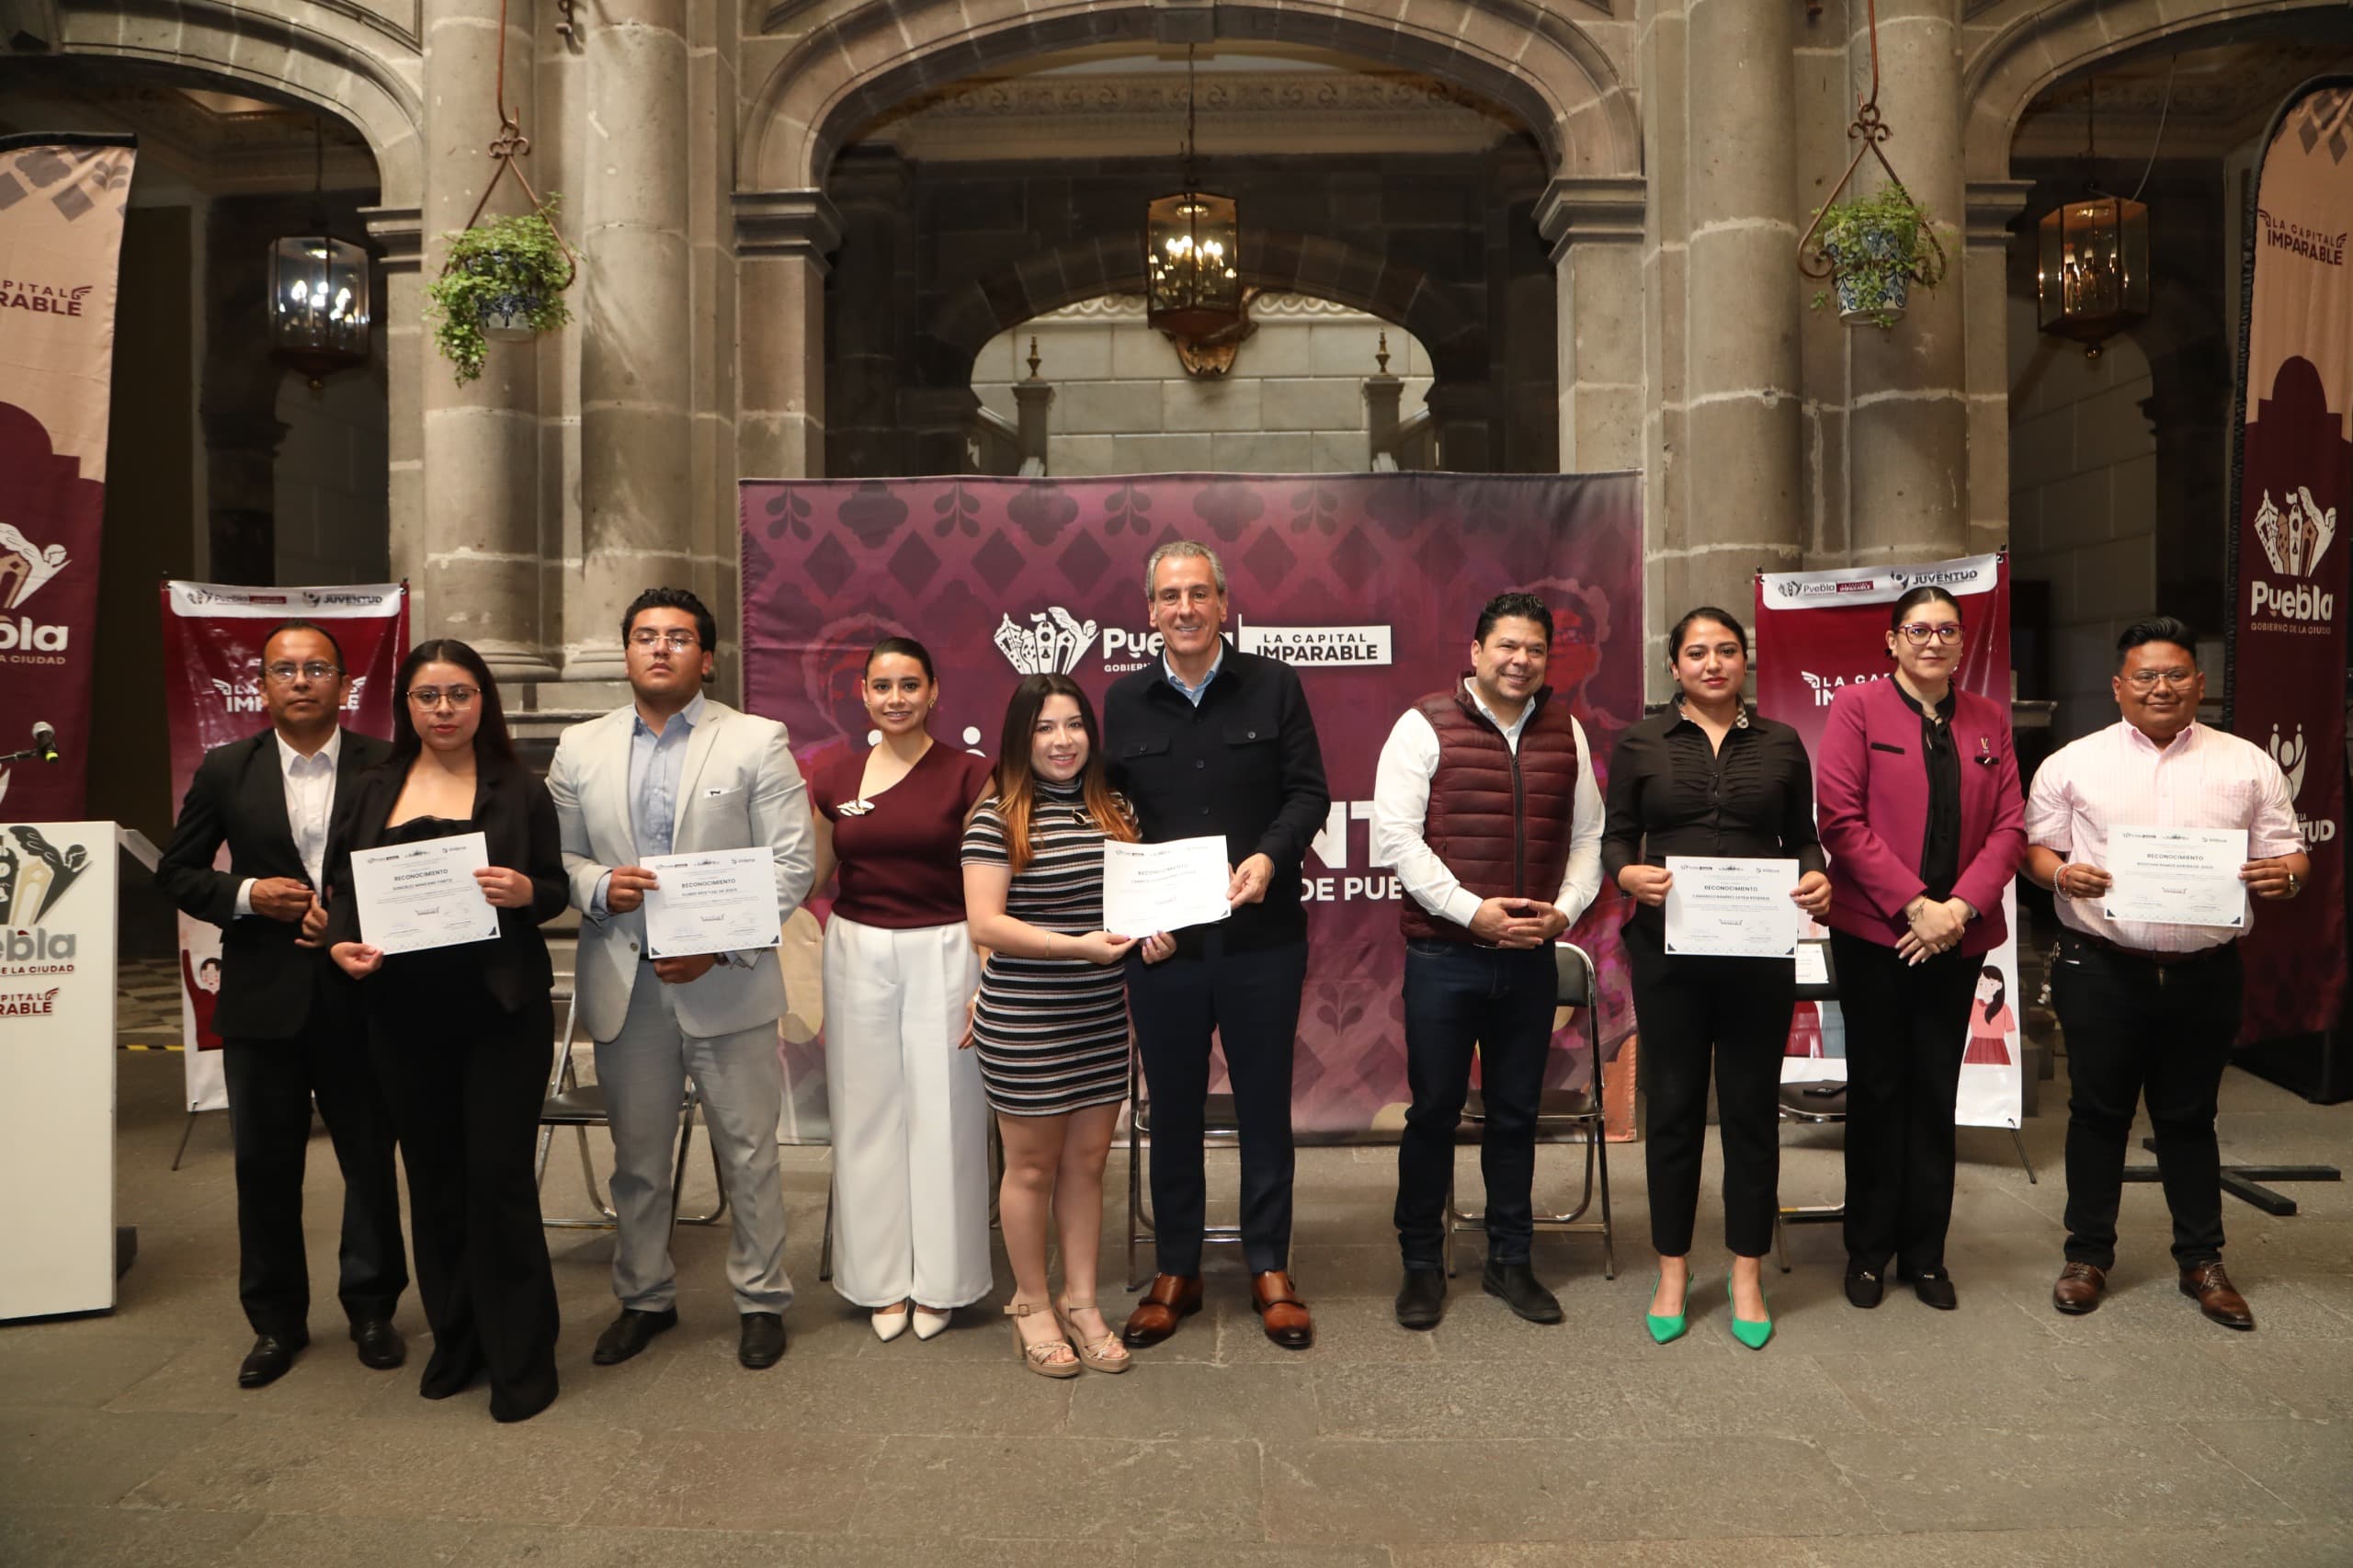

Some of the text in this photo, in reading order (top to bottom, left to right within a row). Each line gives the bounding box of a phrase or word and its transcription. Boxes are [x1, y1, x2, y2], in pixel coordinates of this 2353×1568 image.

[2273, 218, 2335, 247] LA CAPITAL
[2268, 229, 2343, 265] IMPARABLE
[1913, 570, 1978, 585] JUVENTUD
[324, 595, 383, 604] JUVENTUD
[2251, 580, 2334, 621] Puebla
[2250, 622, 2289, 632] GOBIERNO
[1264, 633, 1367, 643] LA CAPITAL
[1256, 644, 1378, 662] IMPARABLE
[10, 654, 66, 665] CIUDAD
[1104, 662, 1151, 673] GOBIER
[1823, 676, 1845, 687] LA
[2146, 853, 2204, 861] RECONOCIMIENTO
[393, 869, 449, 881] RECONOCIMIENTO
[681, 878, 736, 889] RECONOCIMIENTO
[1300, 877, 1336, 902] DE
[12, 966, 26, 974] LA
[28, 964, 74, 973] CIUDAD
